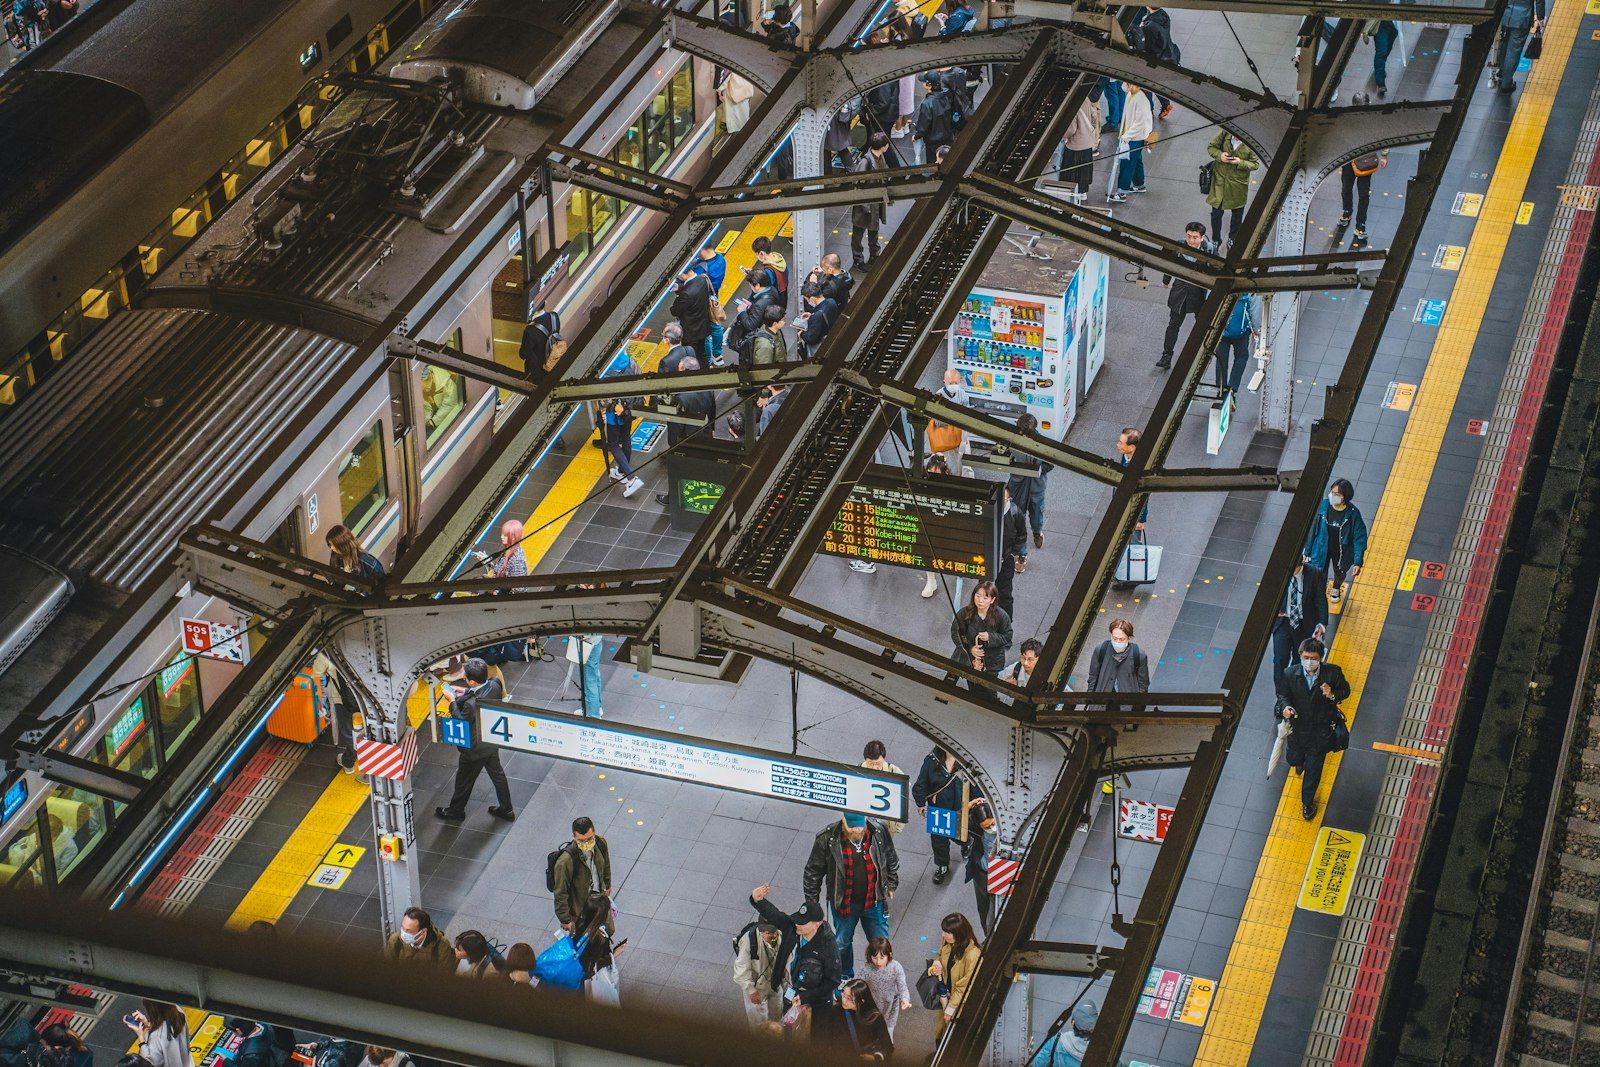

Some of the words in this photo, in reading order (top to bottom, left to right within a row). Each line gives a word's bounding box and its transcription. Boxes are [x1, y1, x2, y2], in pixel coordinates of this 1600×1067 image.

[974, 504, 983, 516] 3
[875, 540, 912, 553] Tottori
[186, 625, 207, 635] SOS
[445, 719, 465, 739] 11
[490, 715, 513, 742] 4
[870, 783, 891, 812] 3
[931, 809, 951, 827] 11
[1321, 847, 1335, 867] Watch
[1316, 867, 1327, 883] your
[1308, 883, 1323, 898] step
